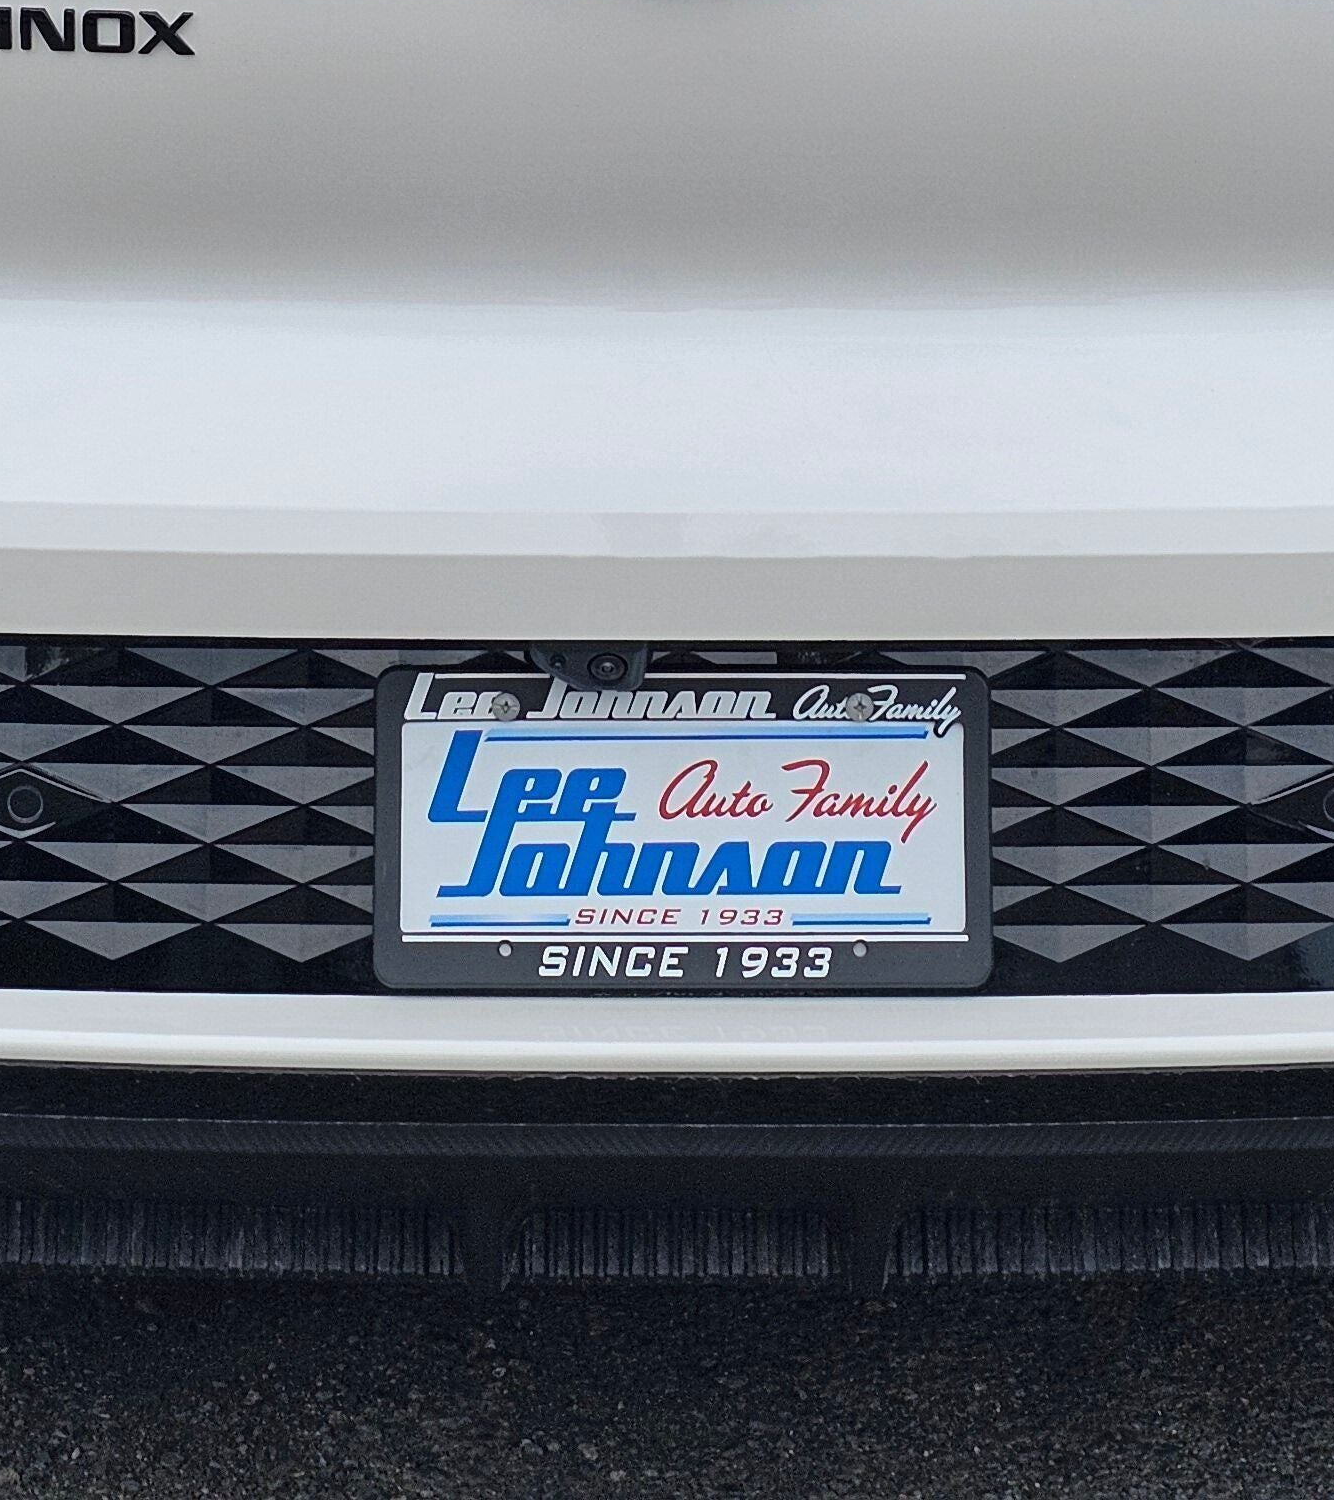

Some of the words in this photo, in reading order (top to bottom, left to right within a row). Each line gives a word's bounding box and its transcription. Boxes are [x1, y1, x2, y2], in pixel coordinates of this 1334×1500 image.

[526, 677, 777, 719] Johnson
[792, 684, 854, 721] Aut
[867, 684, 962, 735] Family
[427, 729, 637, 823] Lee
[658, 758, 774, 821] Auto
[780, 759, 938, 844] Family
[435, 818, 902, 898] Johnson
[574, 908, 682, 925] SINCE
[700, 908, 784, 926] 1933
[538, 944, 690, 978] SINCE
[715, 945, 833, 979] 1933
